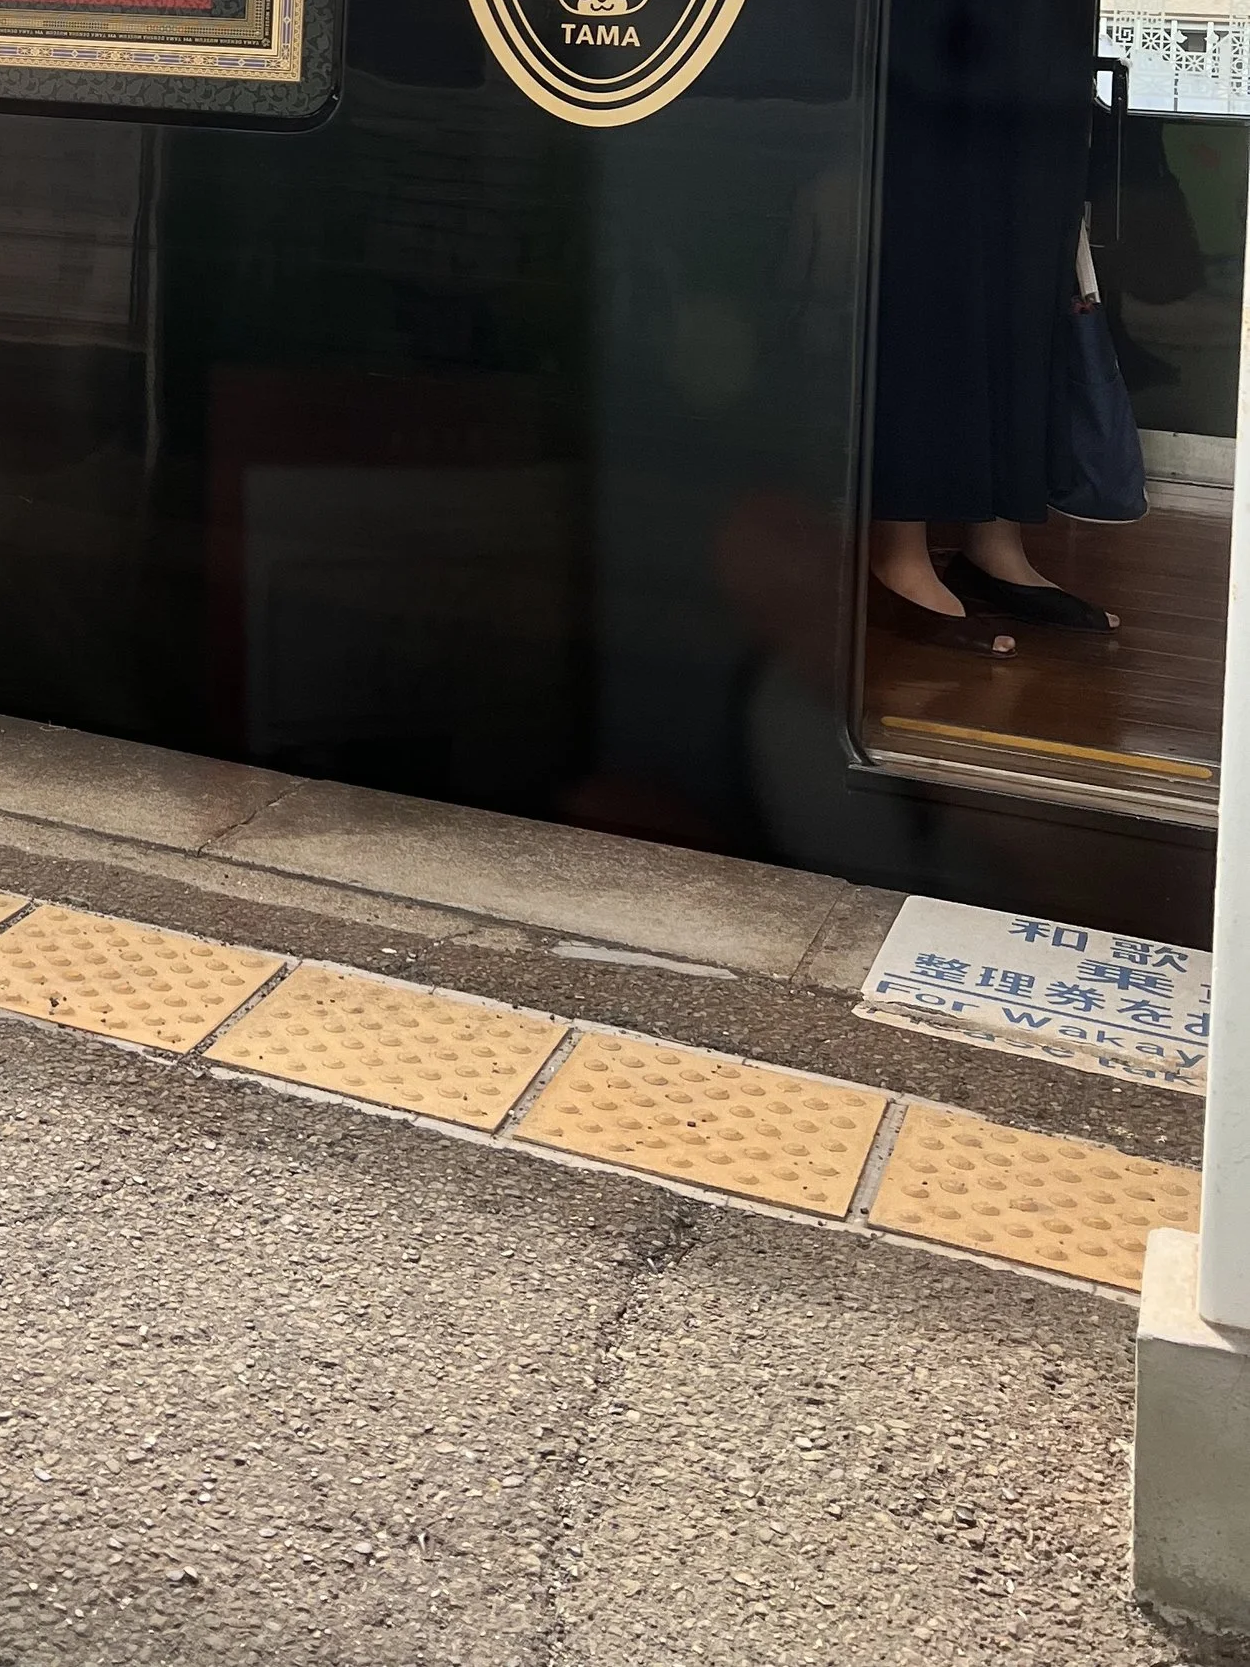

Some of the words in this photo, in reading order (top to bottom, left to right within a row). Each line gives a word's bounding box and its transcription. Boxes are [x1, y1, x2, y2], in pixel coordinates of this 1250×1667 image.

[561, 23, 641, 47] TAMA
[1008, 918, 1189, 973] 和歌
[876, 980, 981, 1014] For
